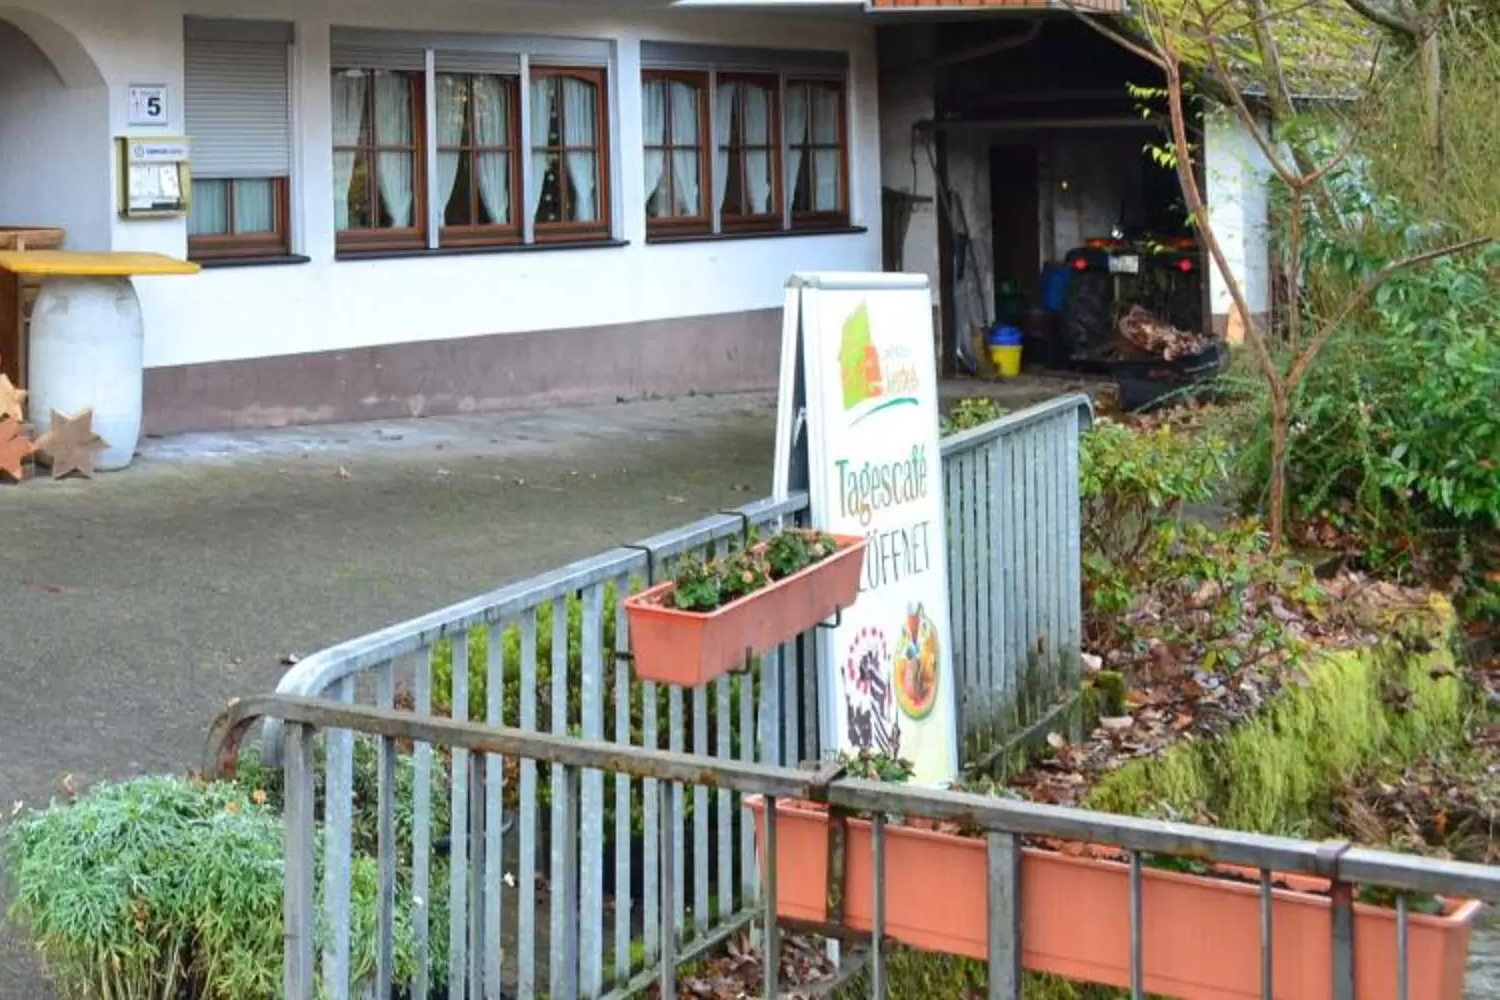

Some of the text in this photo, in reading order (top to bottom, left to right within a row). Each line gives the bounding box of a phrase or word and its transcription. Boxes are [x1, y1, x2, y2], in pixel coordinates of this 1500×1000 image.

[147, 96, 161, 117] 5
[835, 444, 927, 527] Tagescafé
[858, 520, 930, 593] ÖFFNET
